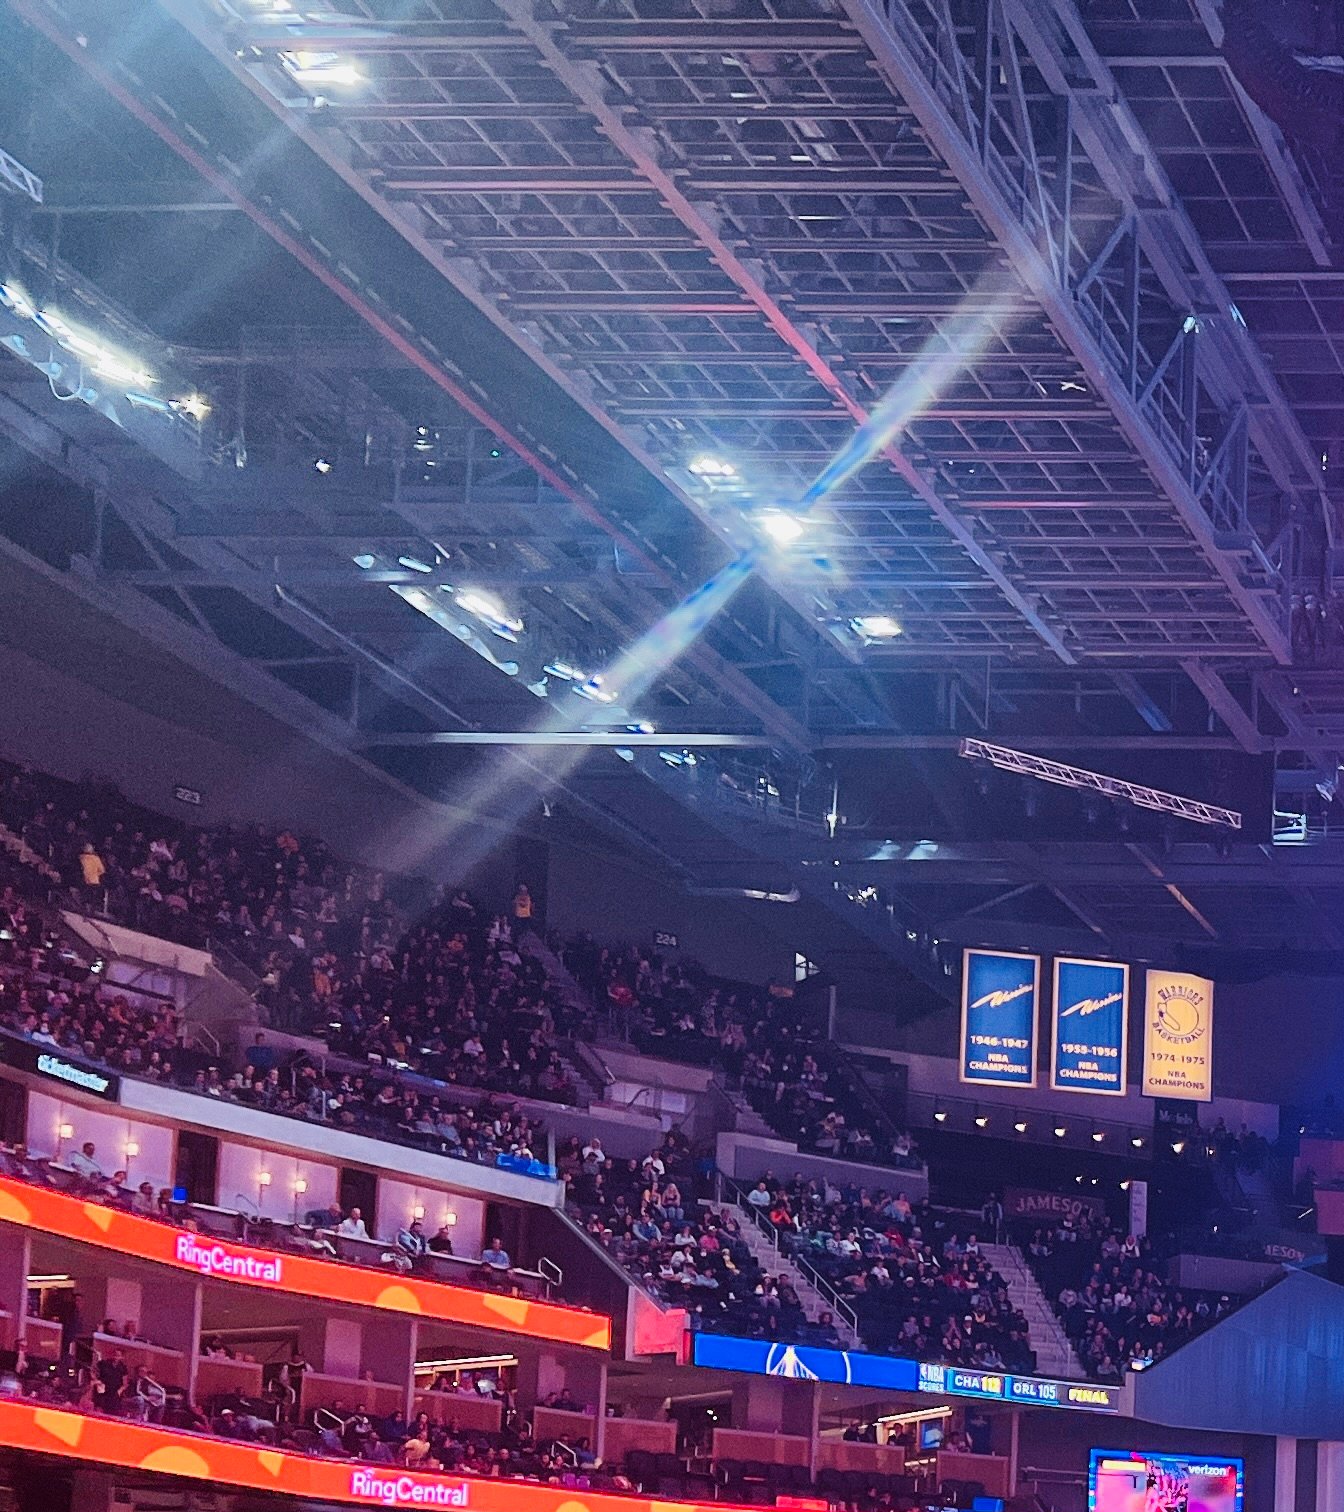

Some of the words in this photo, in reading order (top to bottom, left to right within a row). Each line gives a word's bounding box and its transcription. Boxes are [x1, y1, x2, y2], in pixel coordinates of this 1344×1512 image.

[1158, 986, 1203, 1005] WARRIORS
[1152, 1022, 1205, 1044] BASKETBALL
[1152, 1052, 1205, 1064] 1974-1975
[1149, 1078, 1205, 1089] CHAMPIONS
[176, 1234, 282, 1282] RingCentral
[955, 1375, 979, 1388] CHA
[1013, 1383, 1037, 1396] ORL
[1039, 1385, 1056, 1399] 105
[352, 1468, 469, 1507] RingCentral
